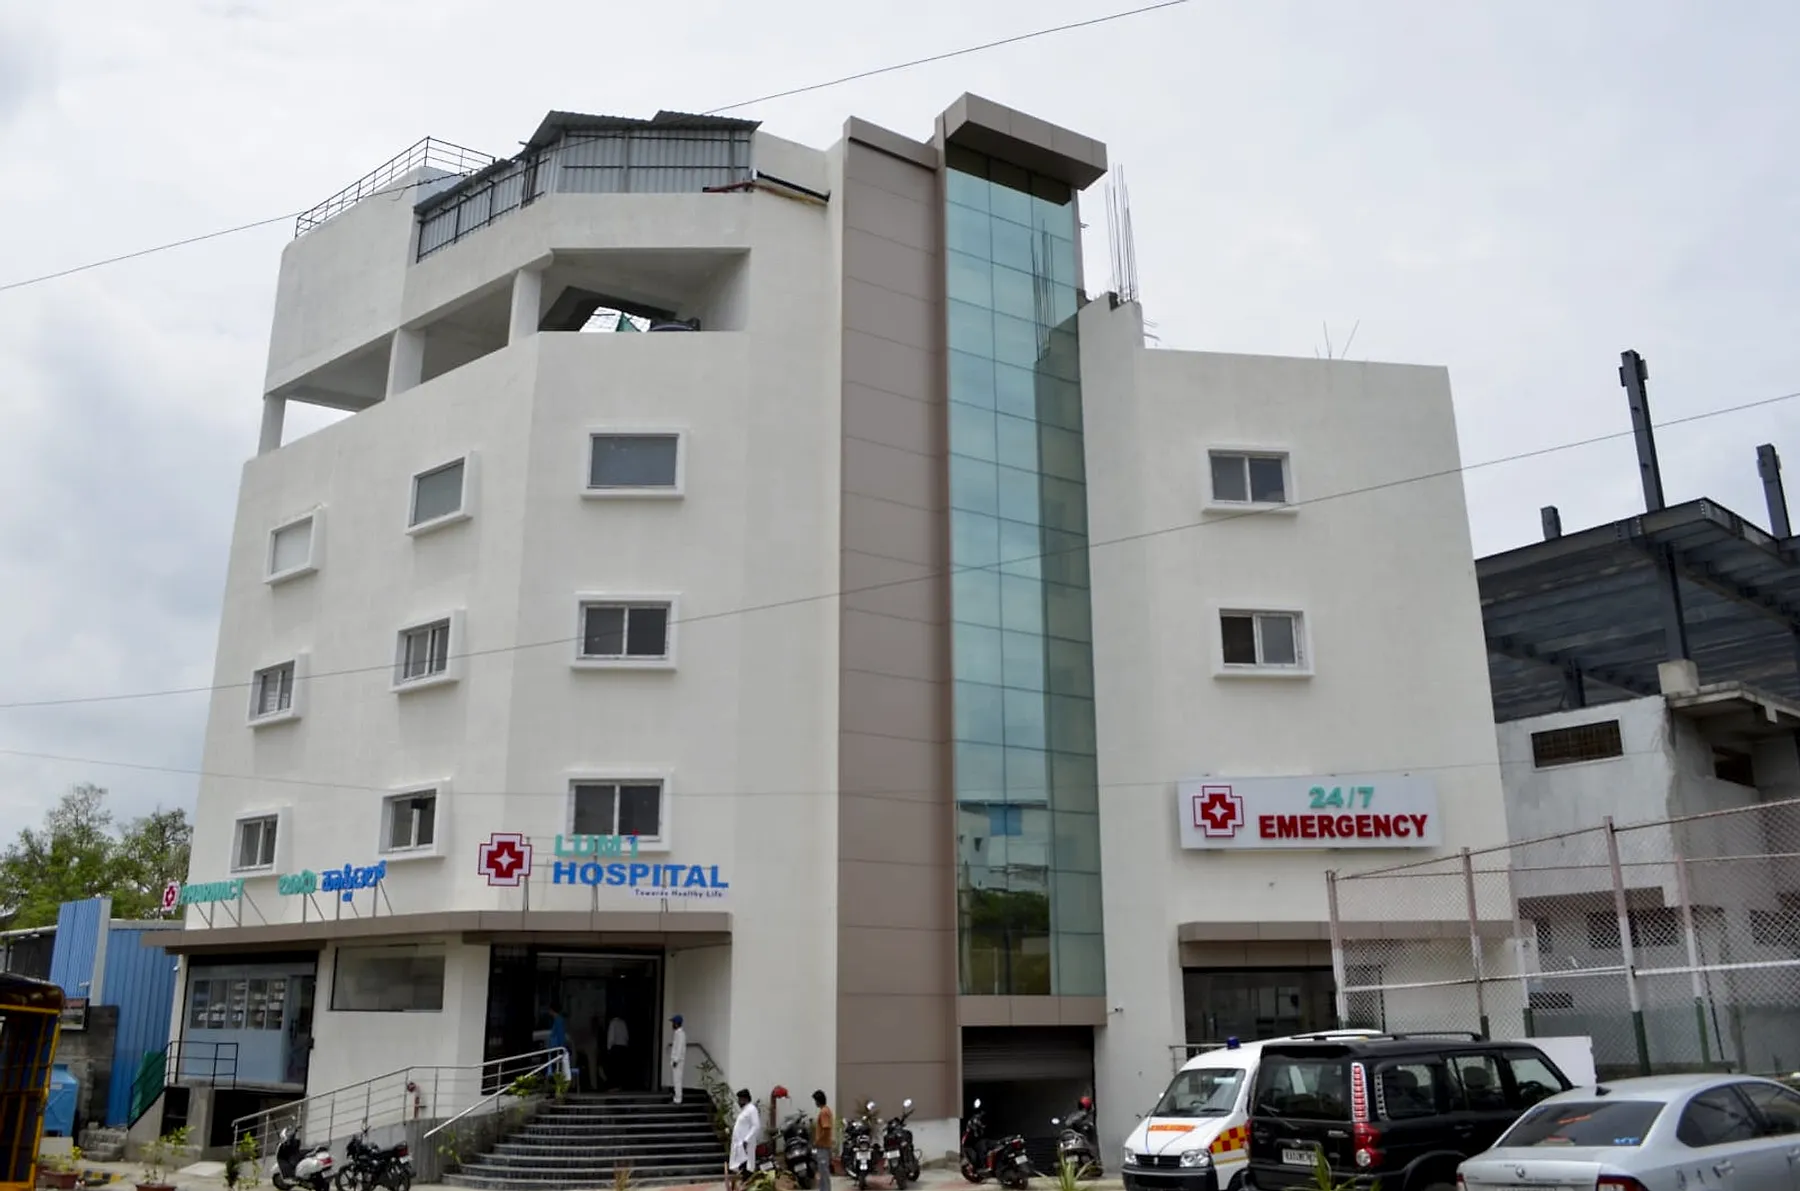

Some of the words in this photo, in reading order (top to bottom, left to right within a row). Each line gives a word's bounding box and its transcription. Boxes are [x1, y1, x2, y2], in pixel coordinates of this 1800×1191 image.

[1308, 786, 1374, 809] 24/7
[1258, 814, 1428, 839] EMERGENCY
[552, 861, 729, 889] HOSPITAL
[181, 877, 245, 904] PHARMACY
[671, 889, 703, 899] Healthy
[706, 890, 723, 898] Life
